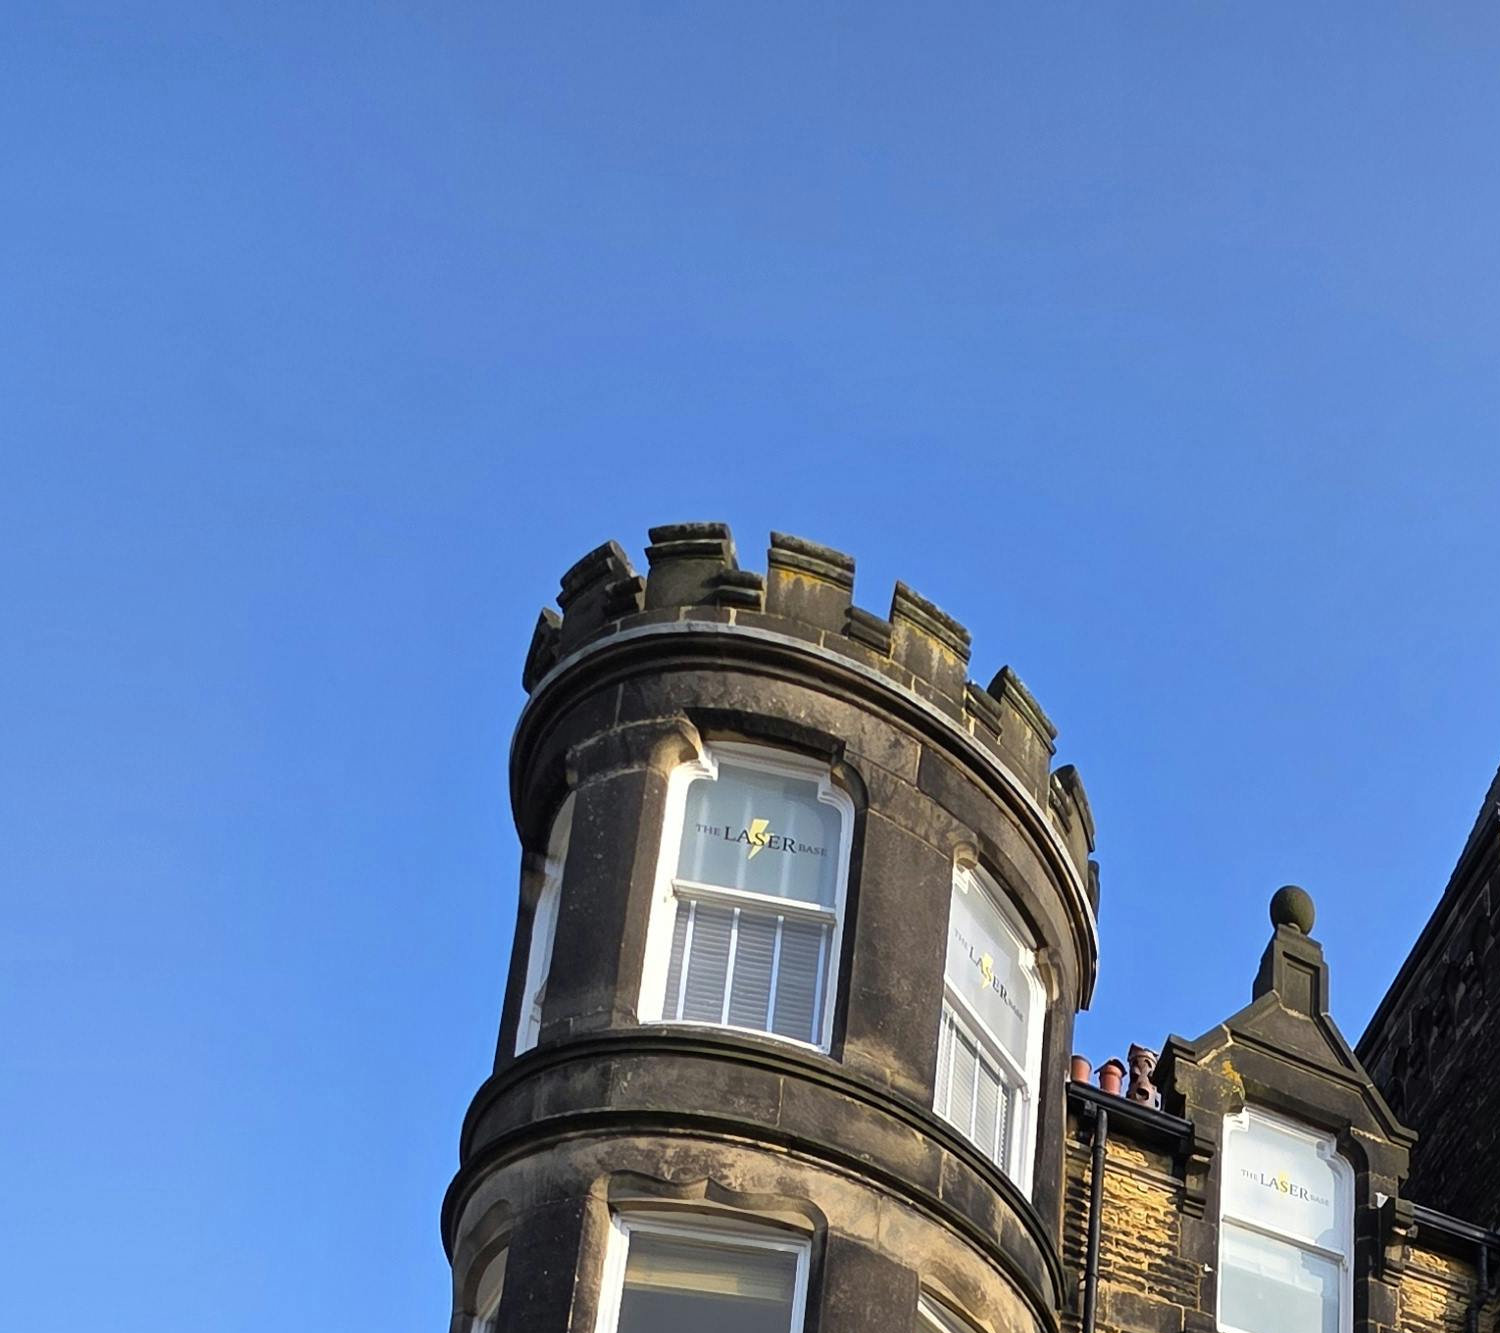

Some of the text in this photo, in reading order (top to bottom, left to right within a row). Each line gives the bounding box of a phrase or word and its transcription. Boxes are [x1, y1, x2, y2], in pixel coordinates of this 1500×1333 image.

[696, 823, 828, 857] THE LASER BASE
[969, 945, 1008, 1006] LASER
[1241, 1168, 1258, 1181] THE
[1260, 1173, 1310, 1201] LASER
